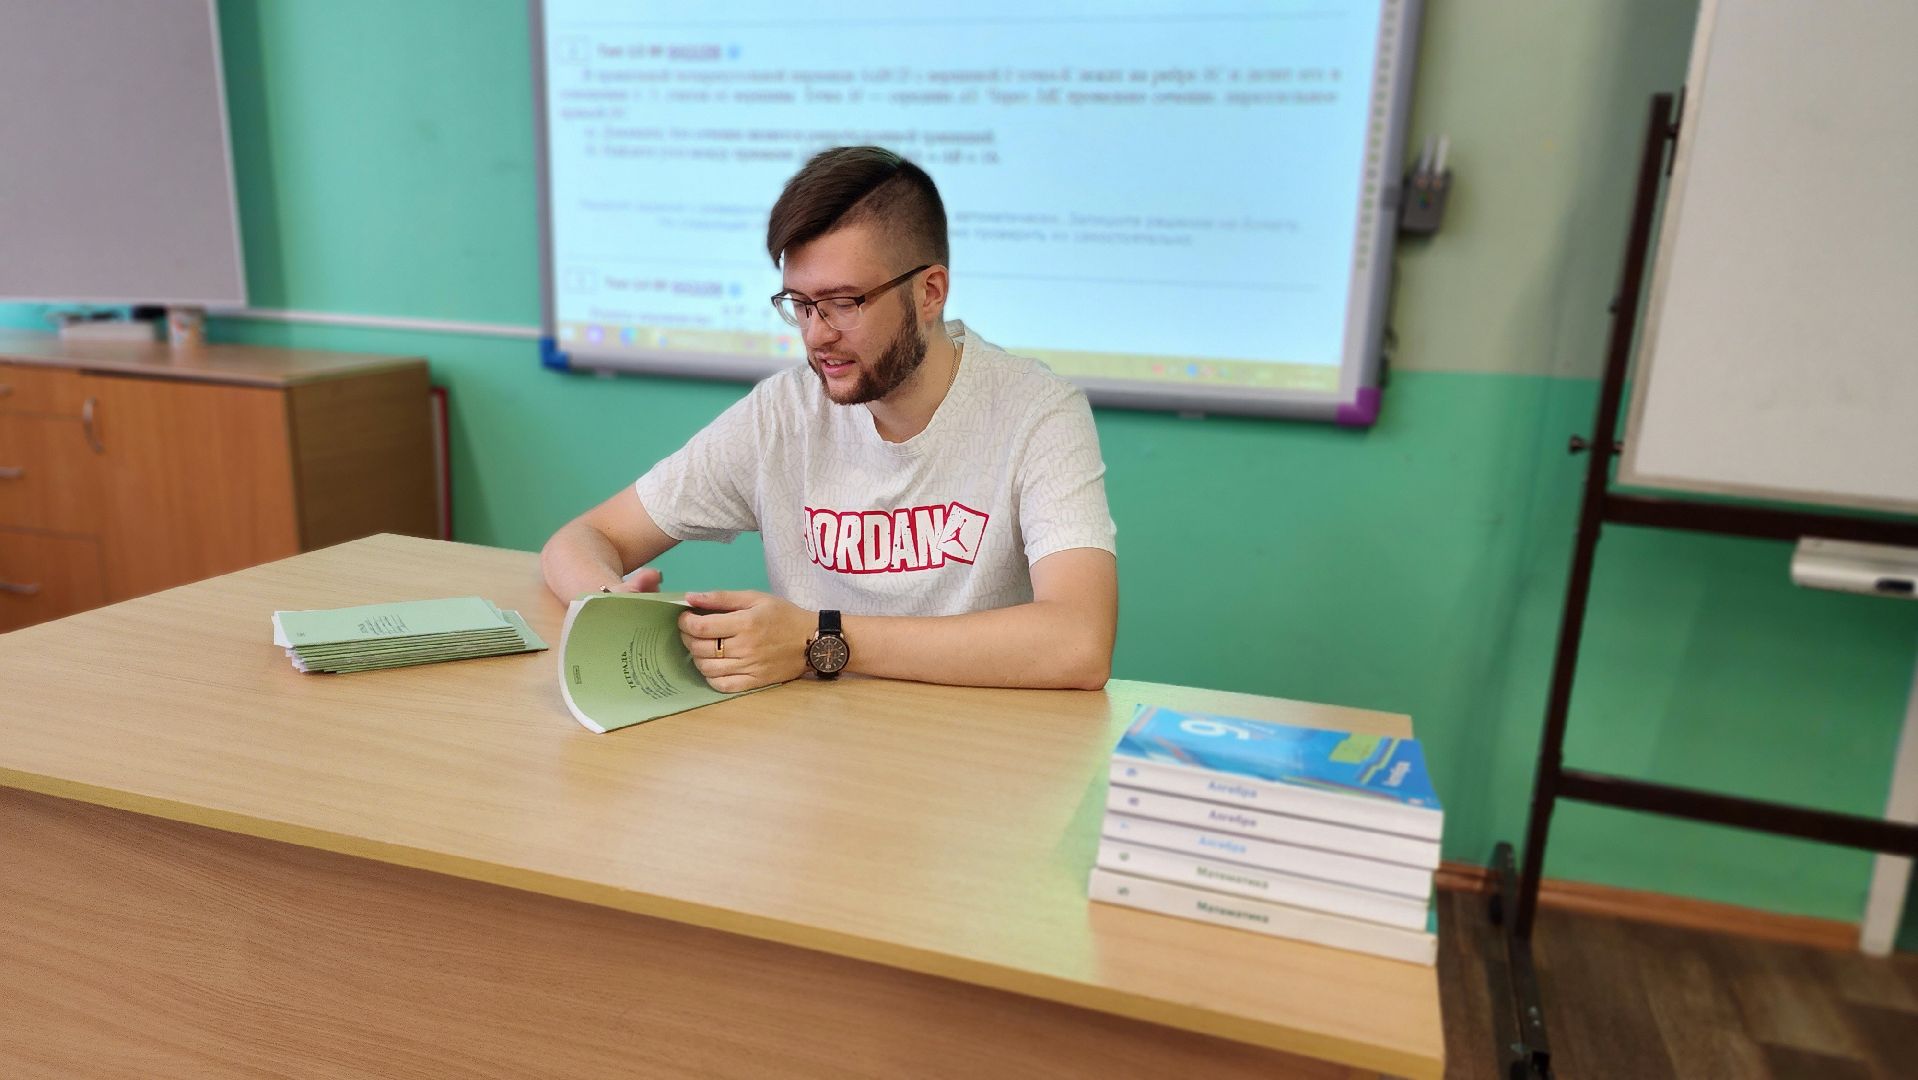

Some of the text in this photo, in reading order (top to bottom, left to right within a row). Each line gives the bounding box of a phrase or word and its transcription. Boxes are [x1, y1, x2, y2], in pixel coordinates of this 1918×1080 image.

[804, 505, 946, 573] JORDAN
[621, 649, 637, 689] ТЕТРАДЬ
[1179, 719, 1250, 740] 9
[1207, 780, 1258, 799] Алгебра
[1208, 809, 1258, 827] Алгебра
[1196, 865, 1269, 889] Математика
[1196, 900, 1270, 923] Математика
